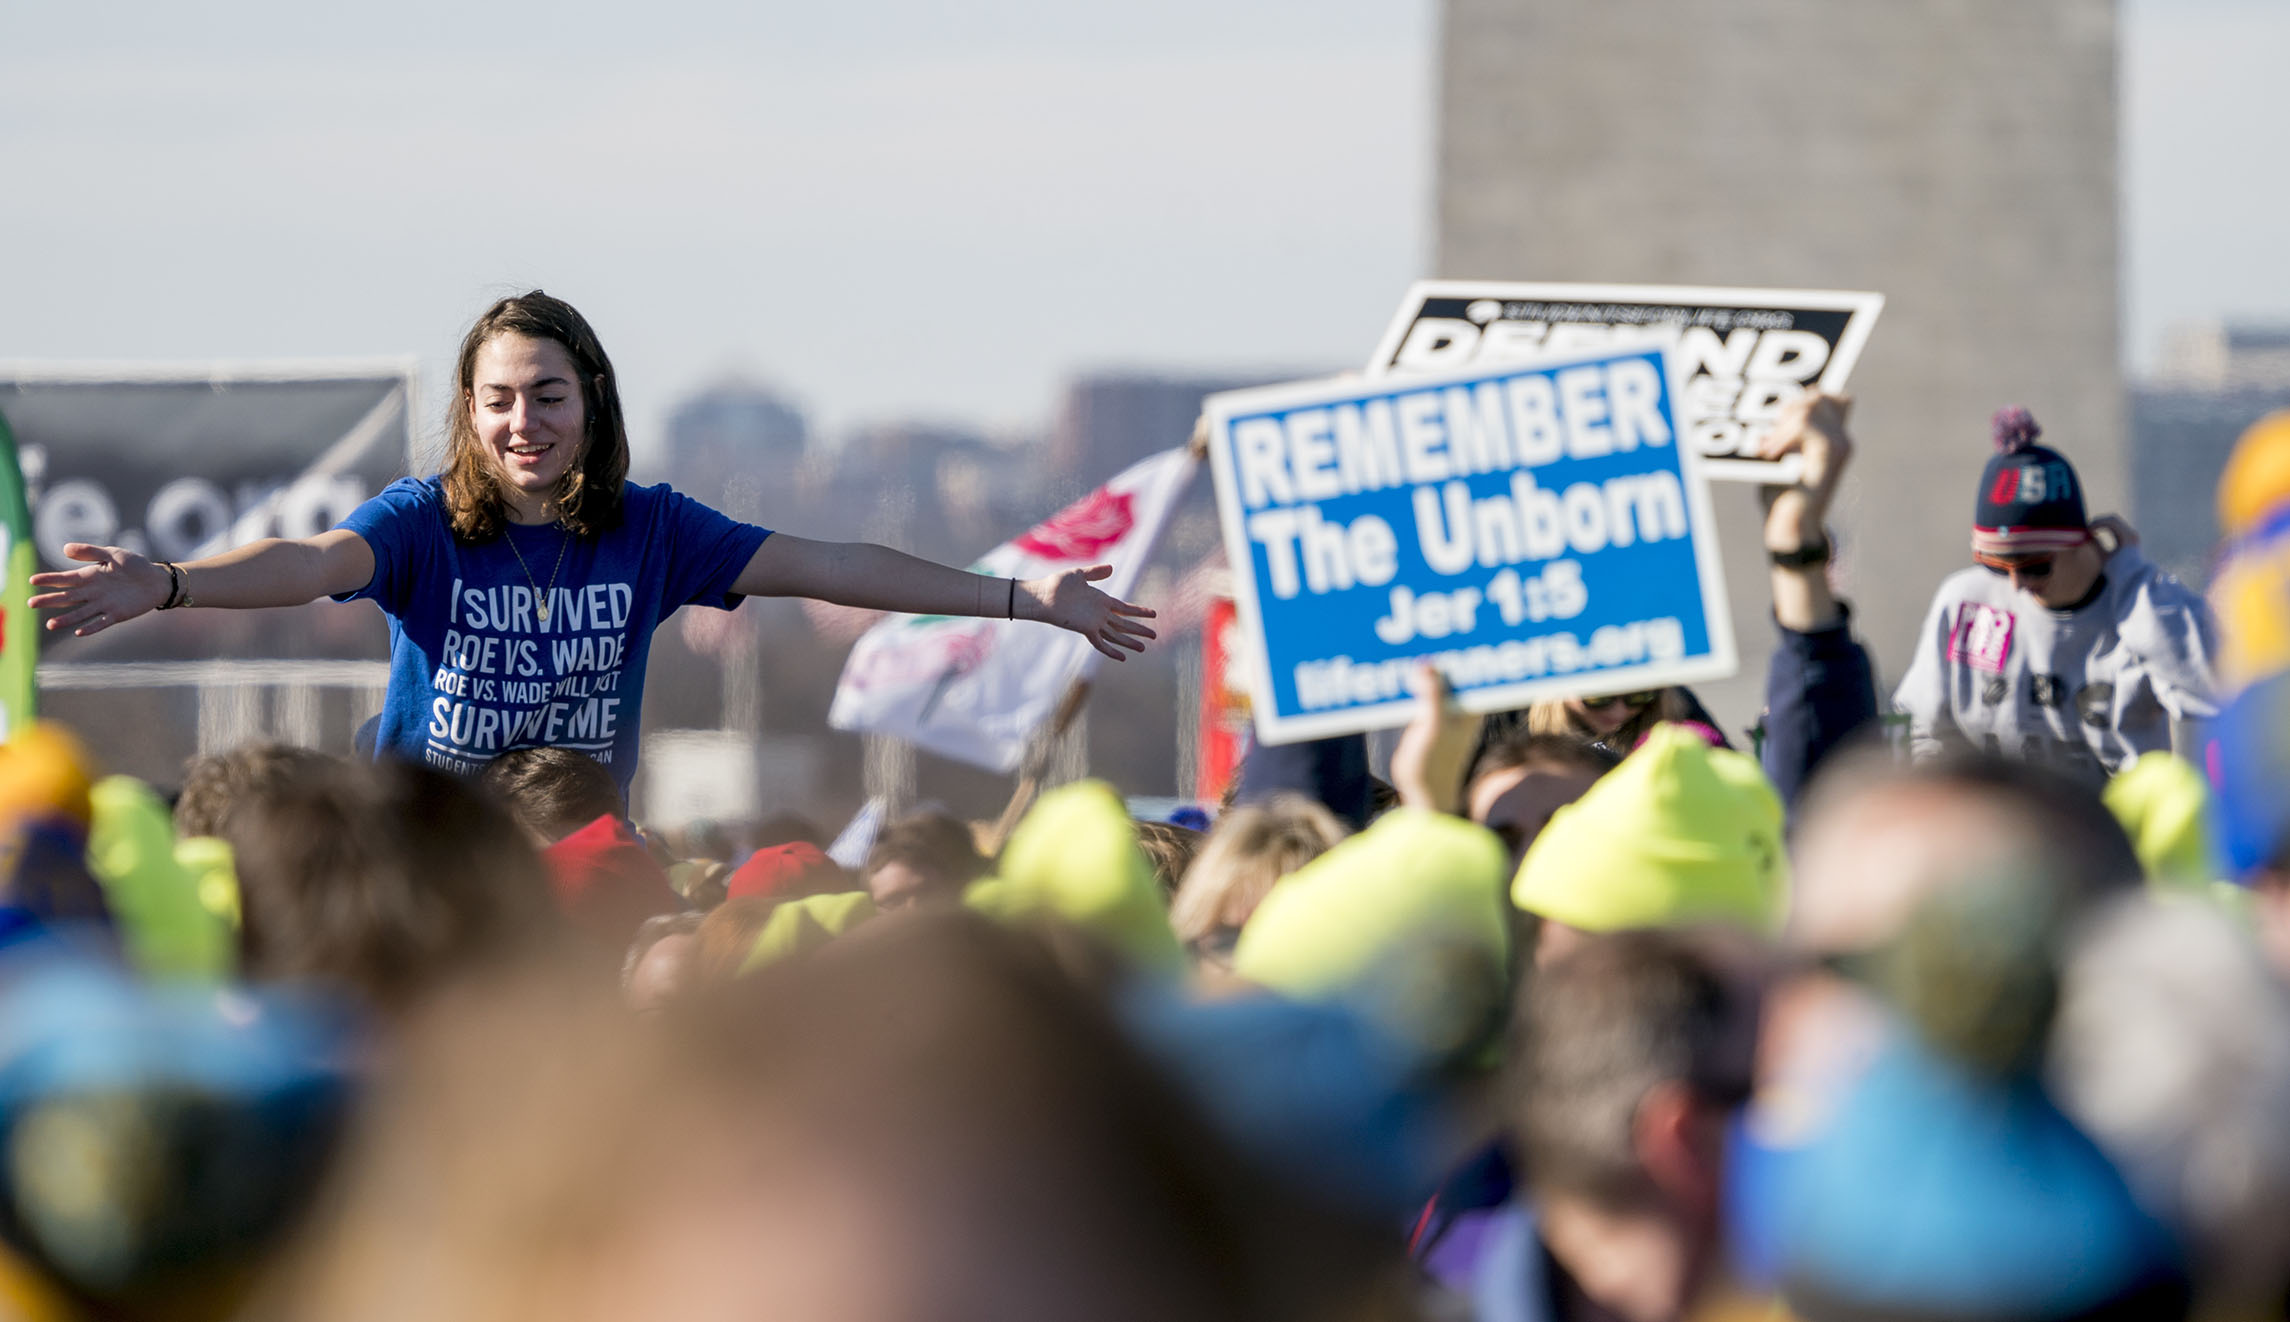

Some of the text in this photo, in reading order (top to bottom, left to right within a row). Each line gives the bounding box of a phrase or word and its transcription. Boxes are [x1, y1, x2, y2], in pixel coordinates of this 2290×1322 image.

[1393, 316, 1831, 383] DEND
[1233, 357, 1671, 509] REMEMBER
[18, 442, 367, 570] e.org
[1247, 469, 1688, 598] The Unborn
[451, 578, 632, 633] I SURVIVED
[1376, 558, 1588, 645] Jer 1:5
[434, 668, 469, 697] ROE
[473, 677, 497, 702] VS.
[502, 680, 552, 704] WADE
[553, 676, 590, 698] WILL
[442, 629, 625, 676] ROE VS. WADE
[429, 696, 620, 750] SURVIVE ME
